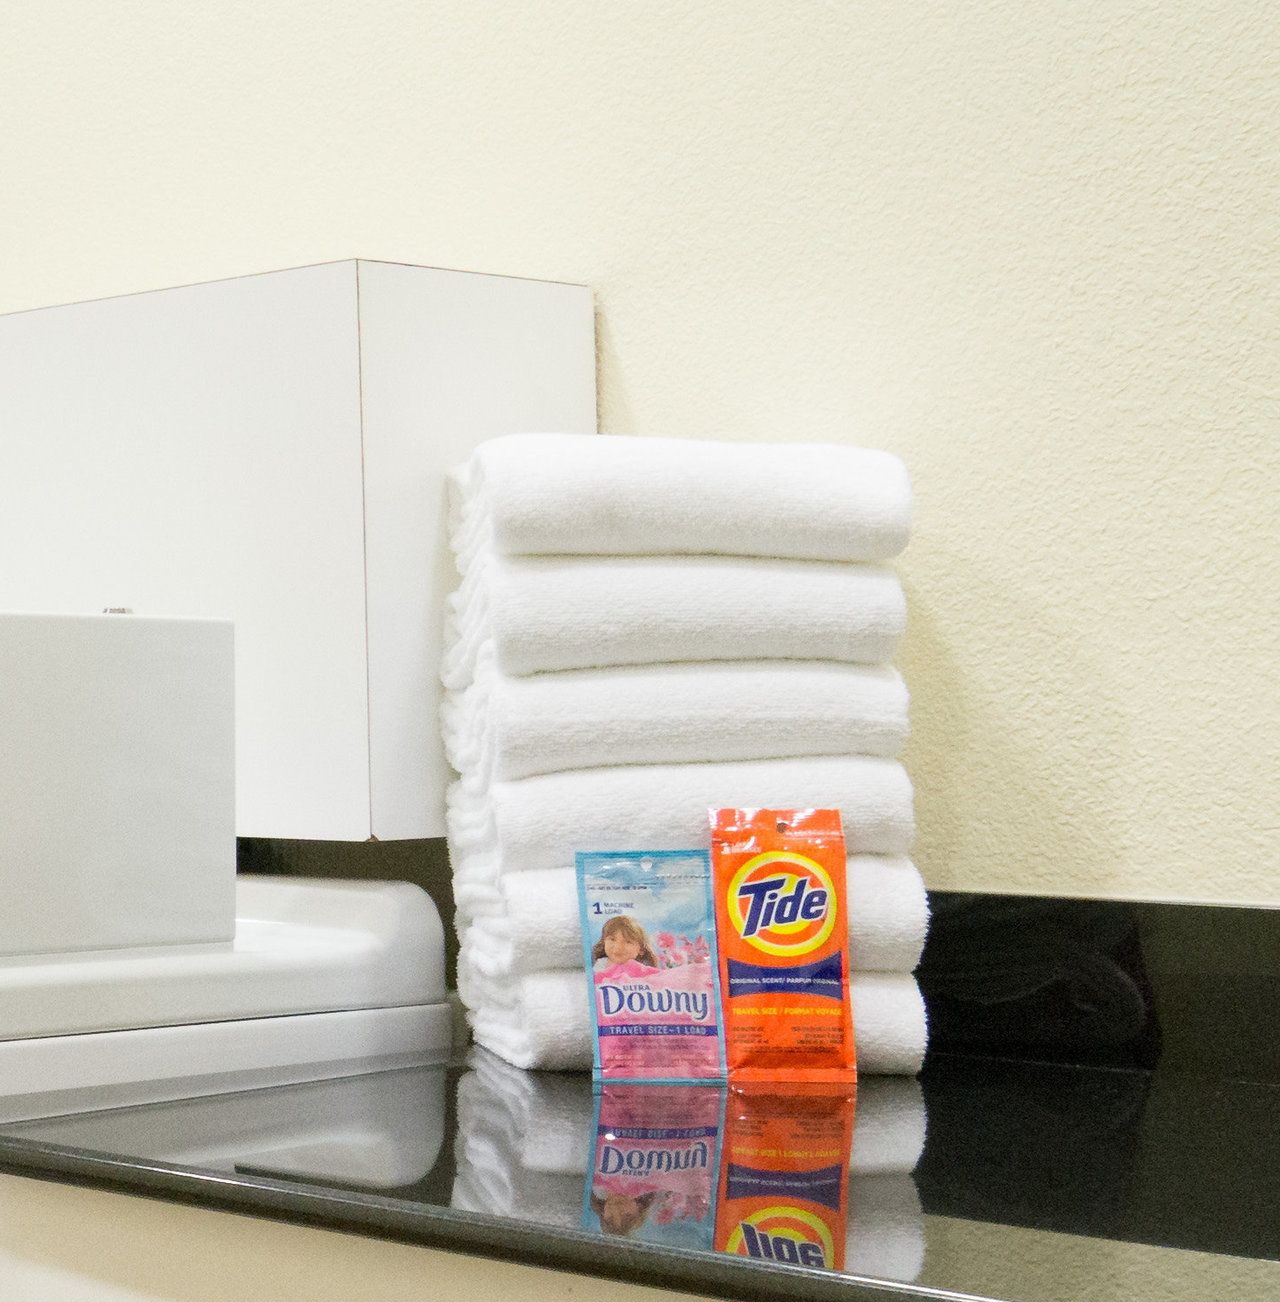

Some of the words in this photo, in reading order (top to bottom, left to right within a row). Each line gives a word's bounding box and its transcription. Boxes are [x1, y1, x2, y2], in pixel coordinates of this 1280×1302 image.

[592, 902, 602, 915] 1
[738, 877, 828, 937] Tide
[599, 985, 709, 1021] Downy
[732, 1007, 760, 1015] TRAVEL
[761, 1007, 778, 1015] SIZE
[784, 1007, 814, 1015] FORMAT
[610, 1026, 645, 1034] TRAVEL
[684, 1026, 707, 1034] LOAD
